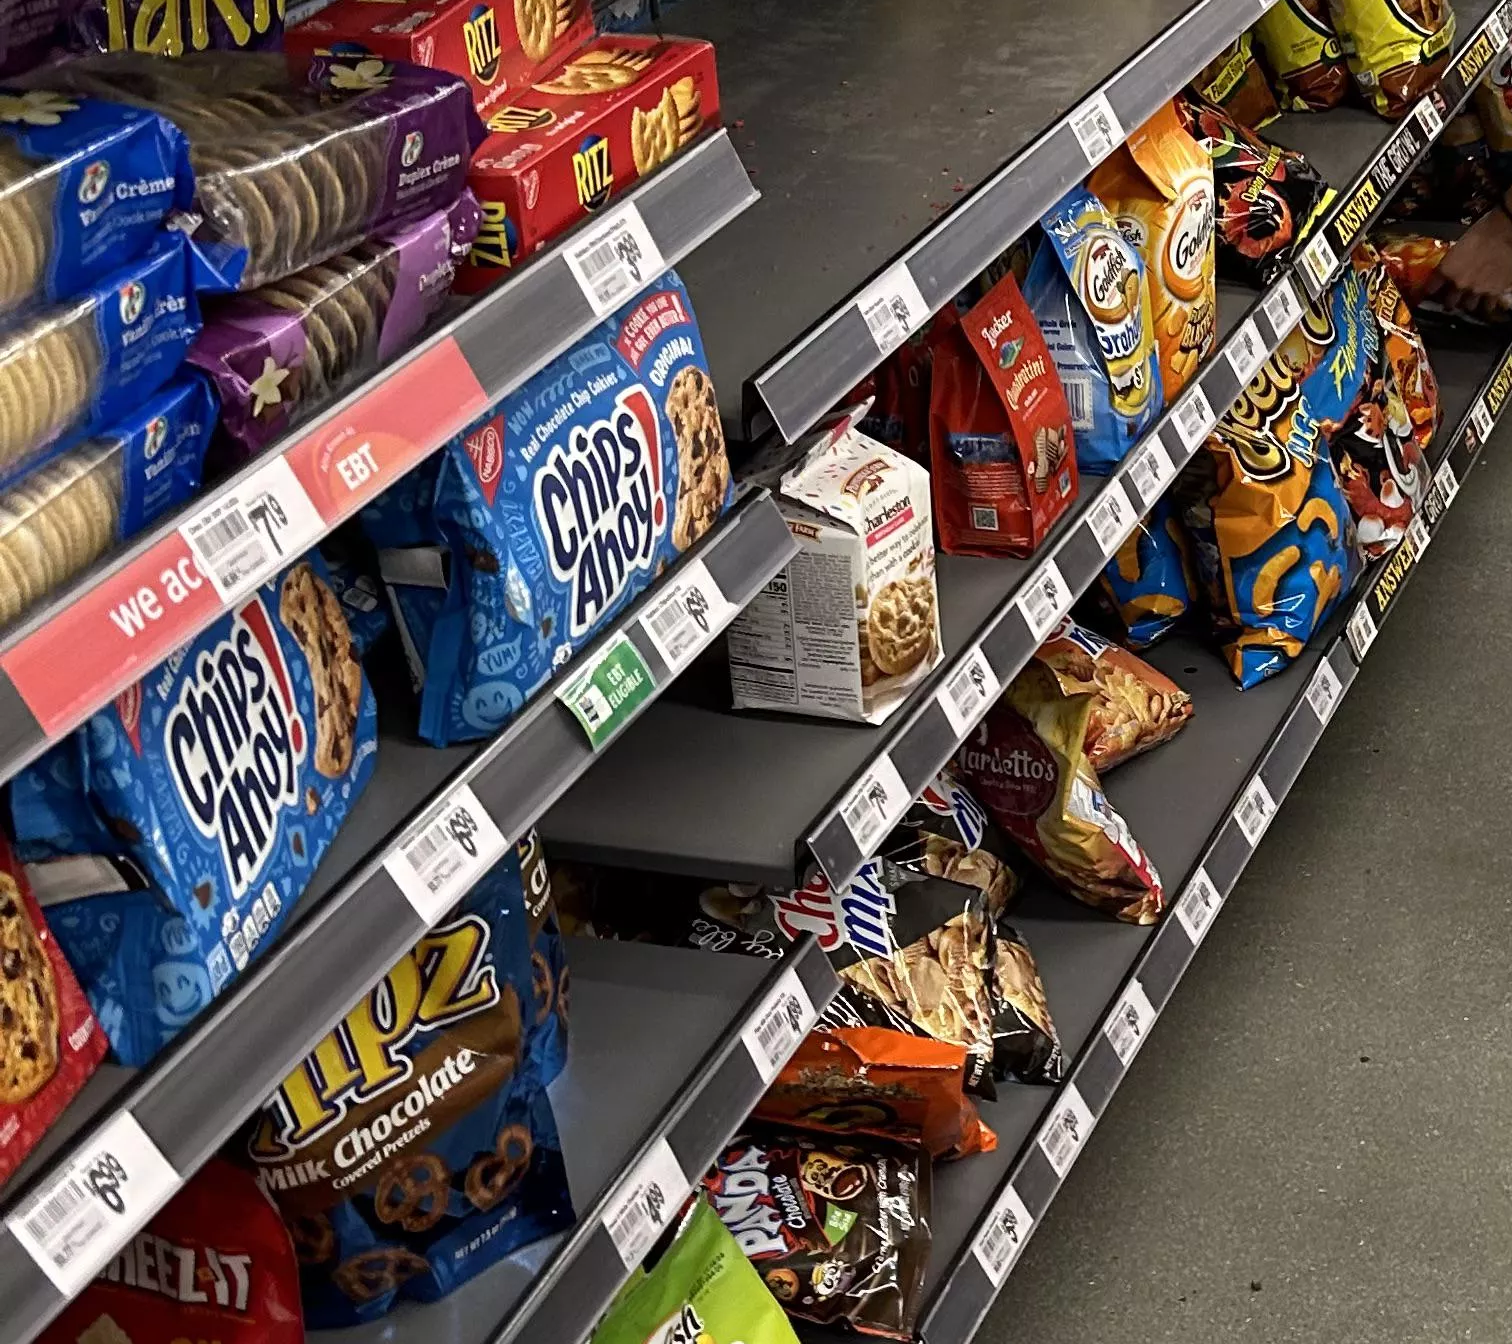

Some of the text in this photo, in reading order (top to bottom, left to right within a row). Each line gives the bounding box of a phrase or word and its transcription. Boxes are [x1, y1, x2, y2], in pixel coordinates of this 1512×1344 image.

[463, 8, 501, 74] RITZ
[1459, 36, 1494, 88] ANSWER
[115, 174, 175, 197] Crème
[573, 137, 615, 207] RITZ
[1338, 126, 1422, 246] ANSWER THE GROWL
[472, 201, 512, 268] RITZ
[1093, 248, 1127, 303] Goldfish
[648, 336, 696, 388] ORIGINAL
[1005, 354, 1047, 412] Quadratini
[519, 370, 620, 465] Real Chocolate Chip Cookies
[335, 440, 380, 492] EBT
[541, 412, 642, 572] Chips
[109, 586, 164, 639] we
[606, 662, 626, 688] EBT
[608, 667, 645, 711] ELIGIBLE
[172, 628, 266, 826] Chips
[258, 1046, 477, 1193] Milk Chocolate
[332, 1117, 432, 1190] Covered Pretzels
[772, 1172, 807, 1230] Chocolate
